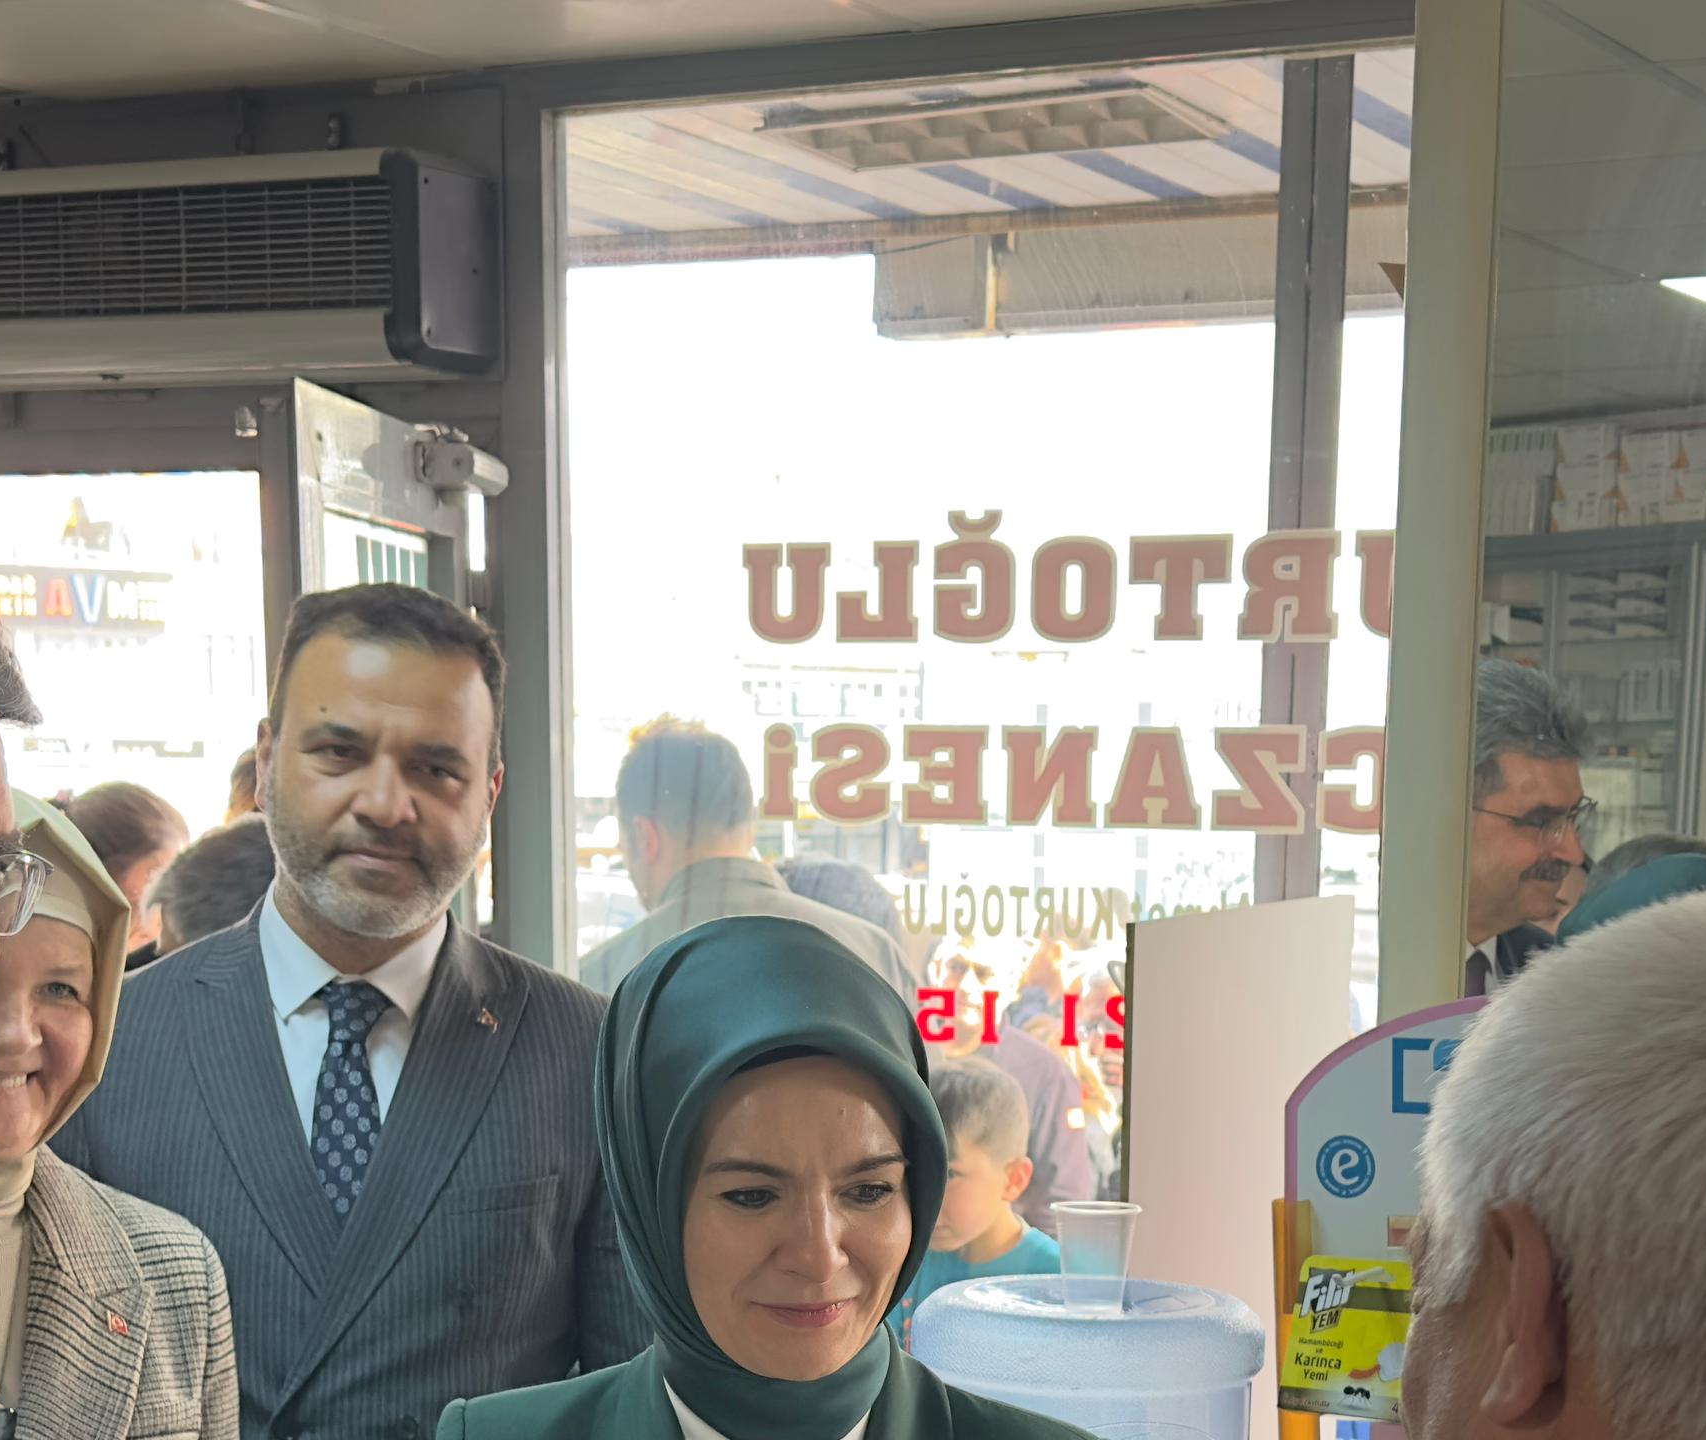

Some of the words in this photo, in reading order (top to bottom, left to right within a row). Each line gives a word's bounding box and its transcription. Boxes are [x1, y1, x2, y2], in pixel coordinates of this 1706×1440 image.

[1312, 1309, 1340, 1331] YEM
[1294, 1352, 1342, 1370] Karınca
[1303, 1368, 1328, 1382] Yemi
